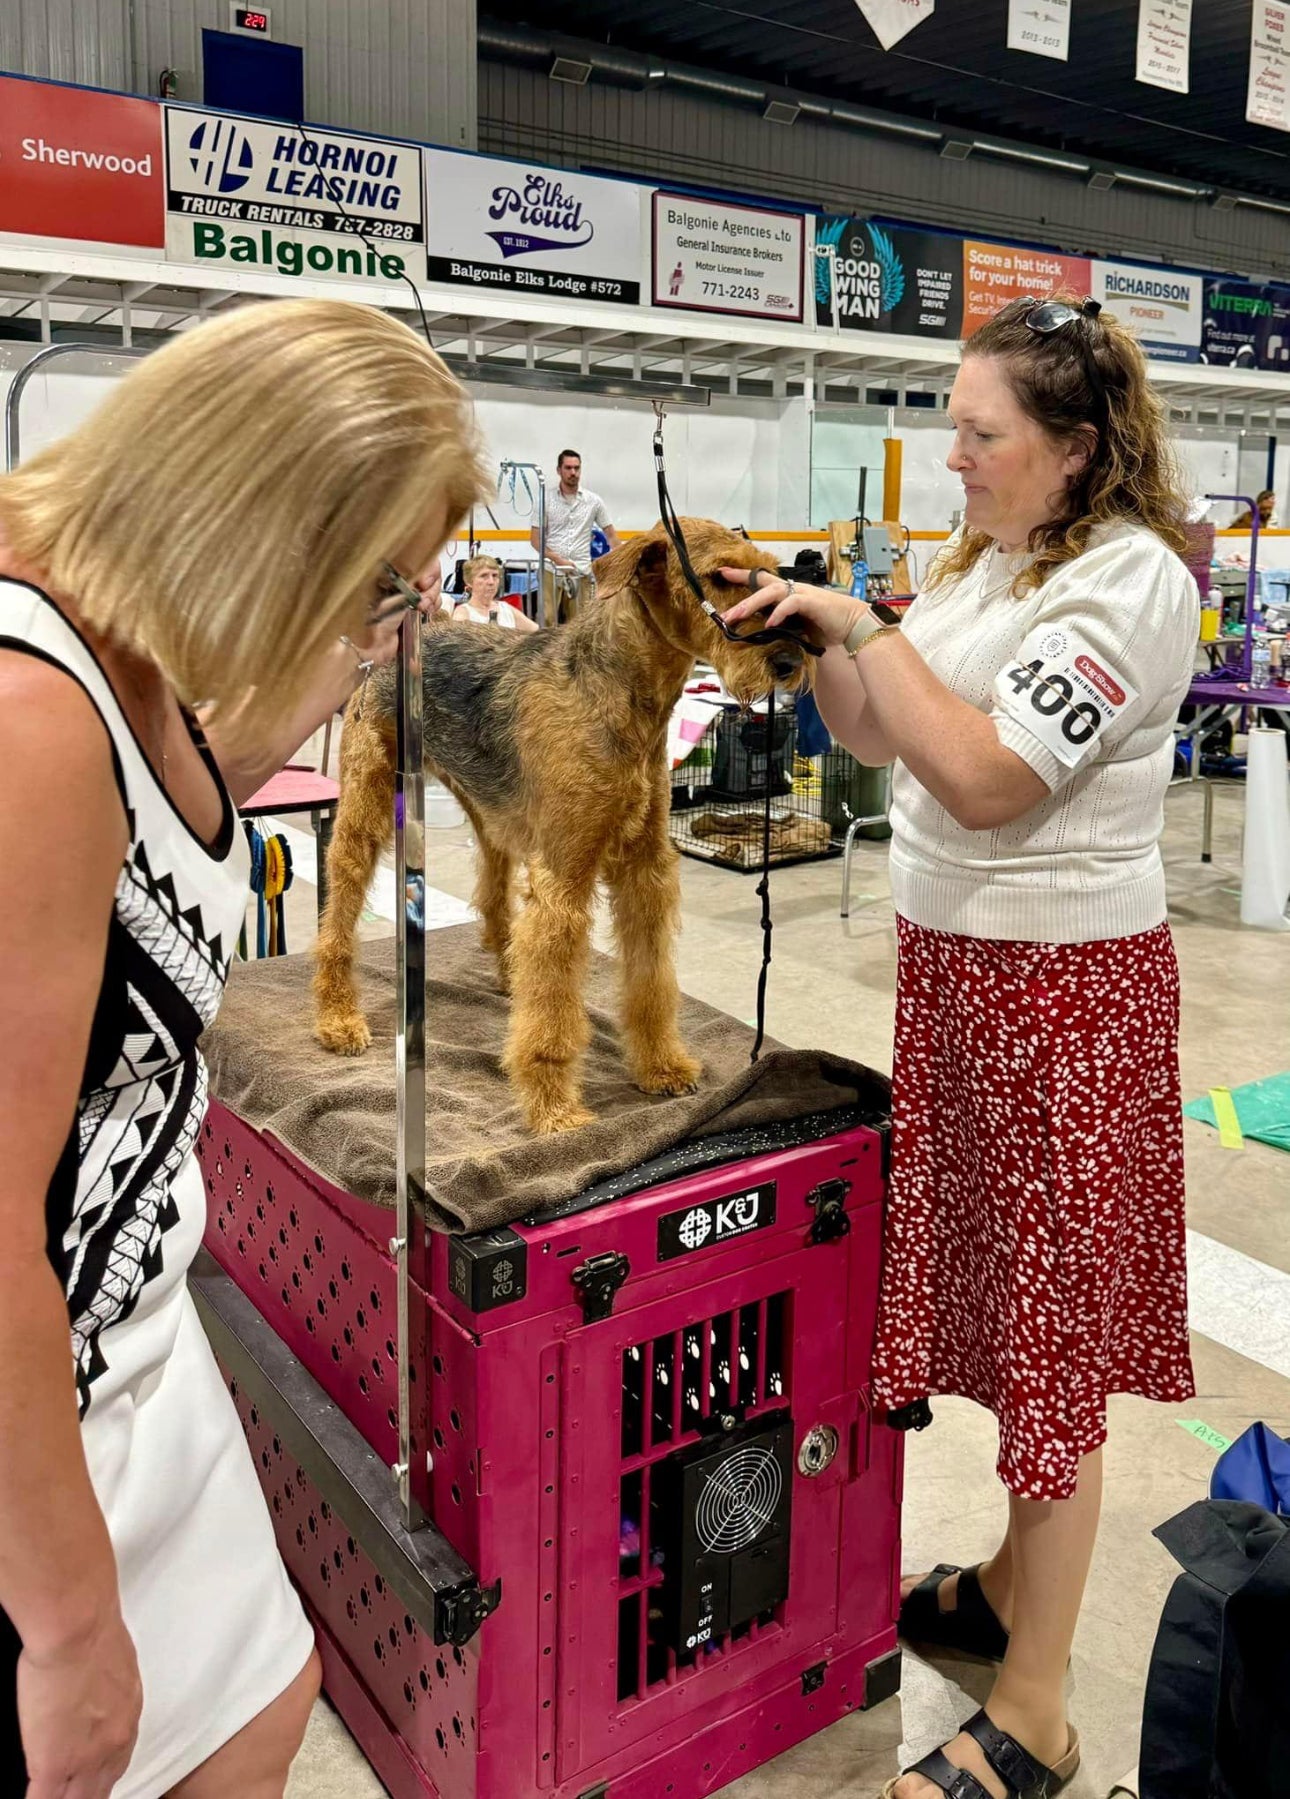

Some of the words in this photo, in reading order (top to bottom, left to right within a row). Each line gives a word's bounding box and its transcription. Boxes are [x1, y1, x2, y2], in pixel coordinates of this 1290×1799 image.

[21, 138, 152, 177] Sherwood
[272, 136, 398, 179] HORNOI
[265, 167, 401, 211] LEASING
[524, 174, 574, 211] Elks
[181, 195, 243, 219] TRUCK
[246, 204, 324, 229] RENTALS
[334, 216, 414, 240] 757-2828
[488, 187, 583, 232] Proud
[667, 209, 719, 231] Balgonie
[722, 219, 772, 239] Agencies
[193, 221, 406, 280] Balgonie
[676, 235, 709, 251] General
[711, 241, 752, 258] Insurance
[753, 247, 783, 262] Brokers
[695, 261, 716, 272] Motor
[717, 264, 742, 276] License
[743, 267, 765, 278] Issuer
[834, 257, 880, 279] GOOD
[969, 249, 1002, 267] Score
[1003, 258, 1012, 269] a
[1014, 255, 1034, 271] hat
[1035, 260, 1062, 276] trick
[450, 262, 512, 282] Balgonie
[515, 271, 545, 287] Elks
[548, 275, 587, 294] Lodge
[590, 281, 622, 296] #572
[835, 275, 880, 298] WING
[917, 278, 952, 291] IMPAIRED
[939, 271, 953, 281] LET
[969, 266, 986, 282] for
[988, 271, 1015, 287] your
[1017, 273, 1054, 291] home!
[702, 281, 760, 301] 771-2243
[919, 288, 950, 301] FRIENDS
[968, 291, 983, 302] Get
[836, 295, 880, 320] MAN
[921, 299, 946, 310] DRIVE.
[1129, 306, 1165, 320] PIONEER
[1210, 293, 1272, 317] VITERRA
[1006, 659, 1101, 745] 400
[716, 1191, 759, 1235] K&J
[701, 1582, 713, 1593] ON
[698, 1614, 713, 1627] OFF
